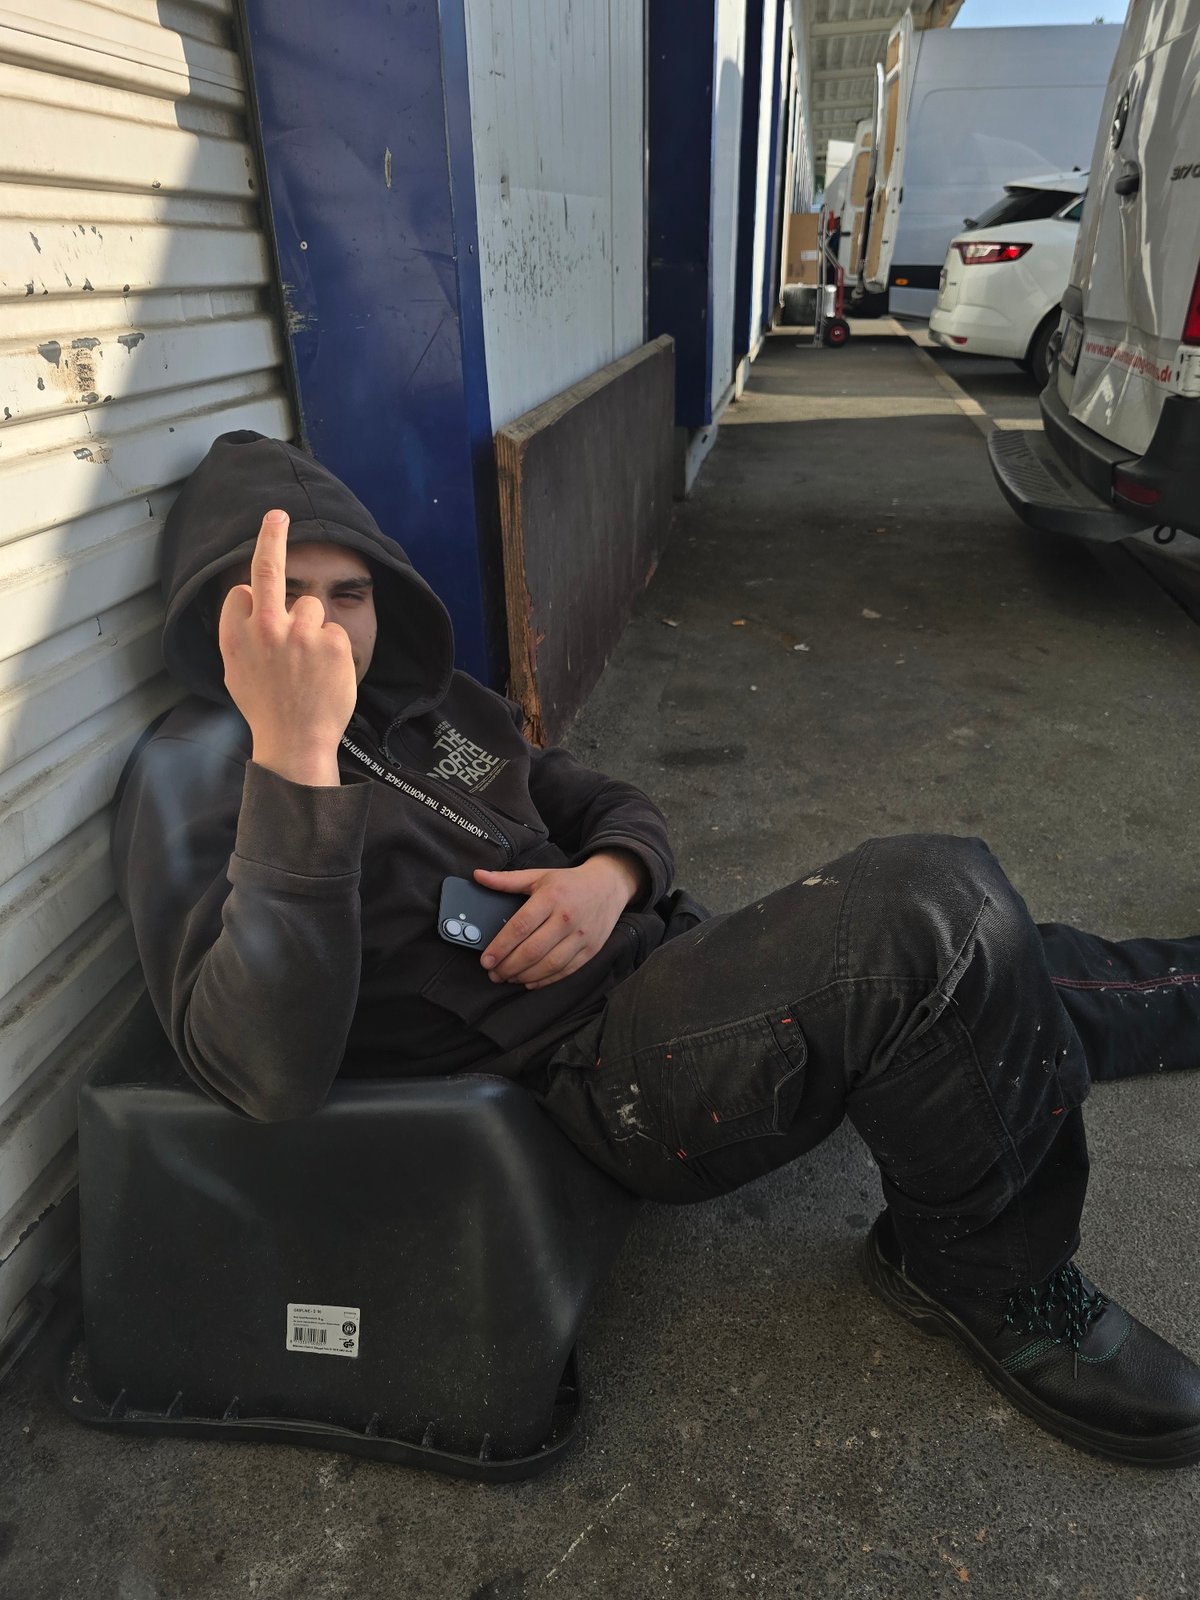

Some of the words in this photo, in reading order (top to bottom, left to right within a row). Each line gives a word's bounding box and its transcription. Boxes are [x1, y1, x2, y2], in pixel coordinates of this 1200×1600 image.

[341, 735, 352, 748] FA
[433, 728, 468, 753] THE
[349, 744, 373, 766] NORTH
[369, 761, 385, 776] THE
[456, 751, 500, 786] FACE
[384, 772, 404, 788] FACE
[401, 782, 426, 801] NORTH
[424, 796, 439, 810] THE
[439, 805, 459, 822] FACE
[457, 817, 483, 837] NORTH
